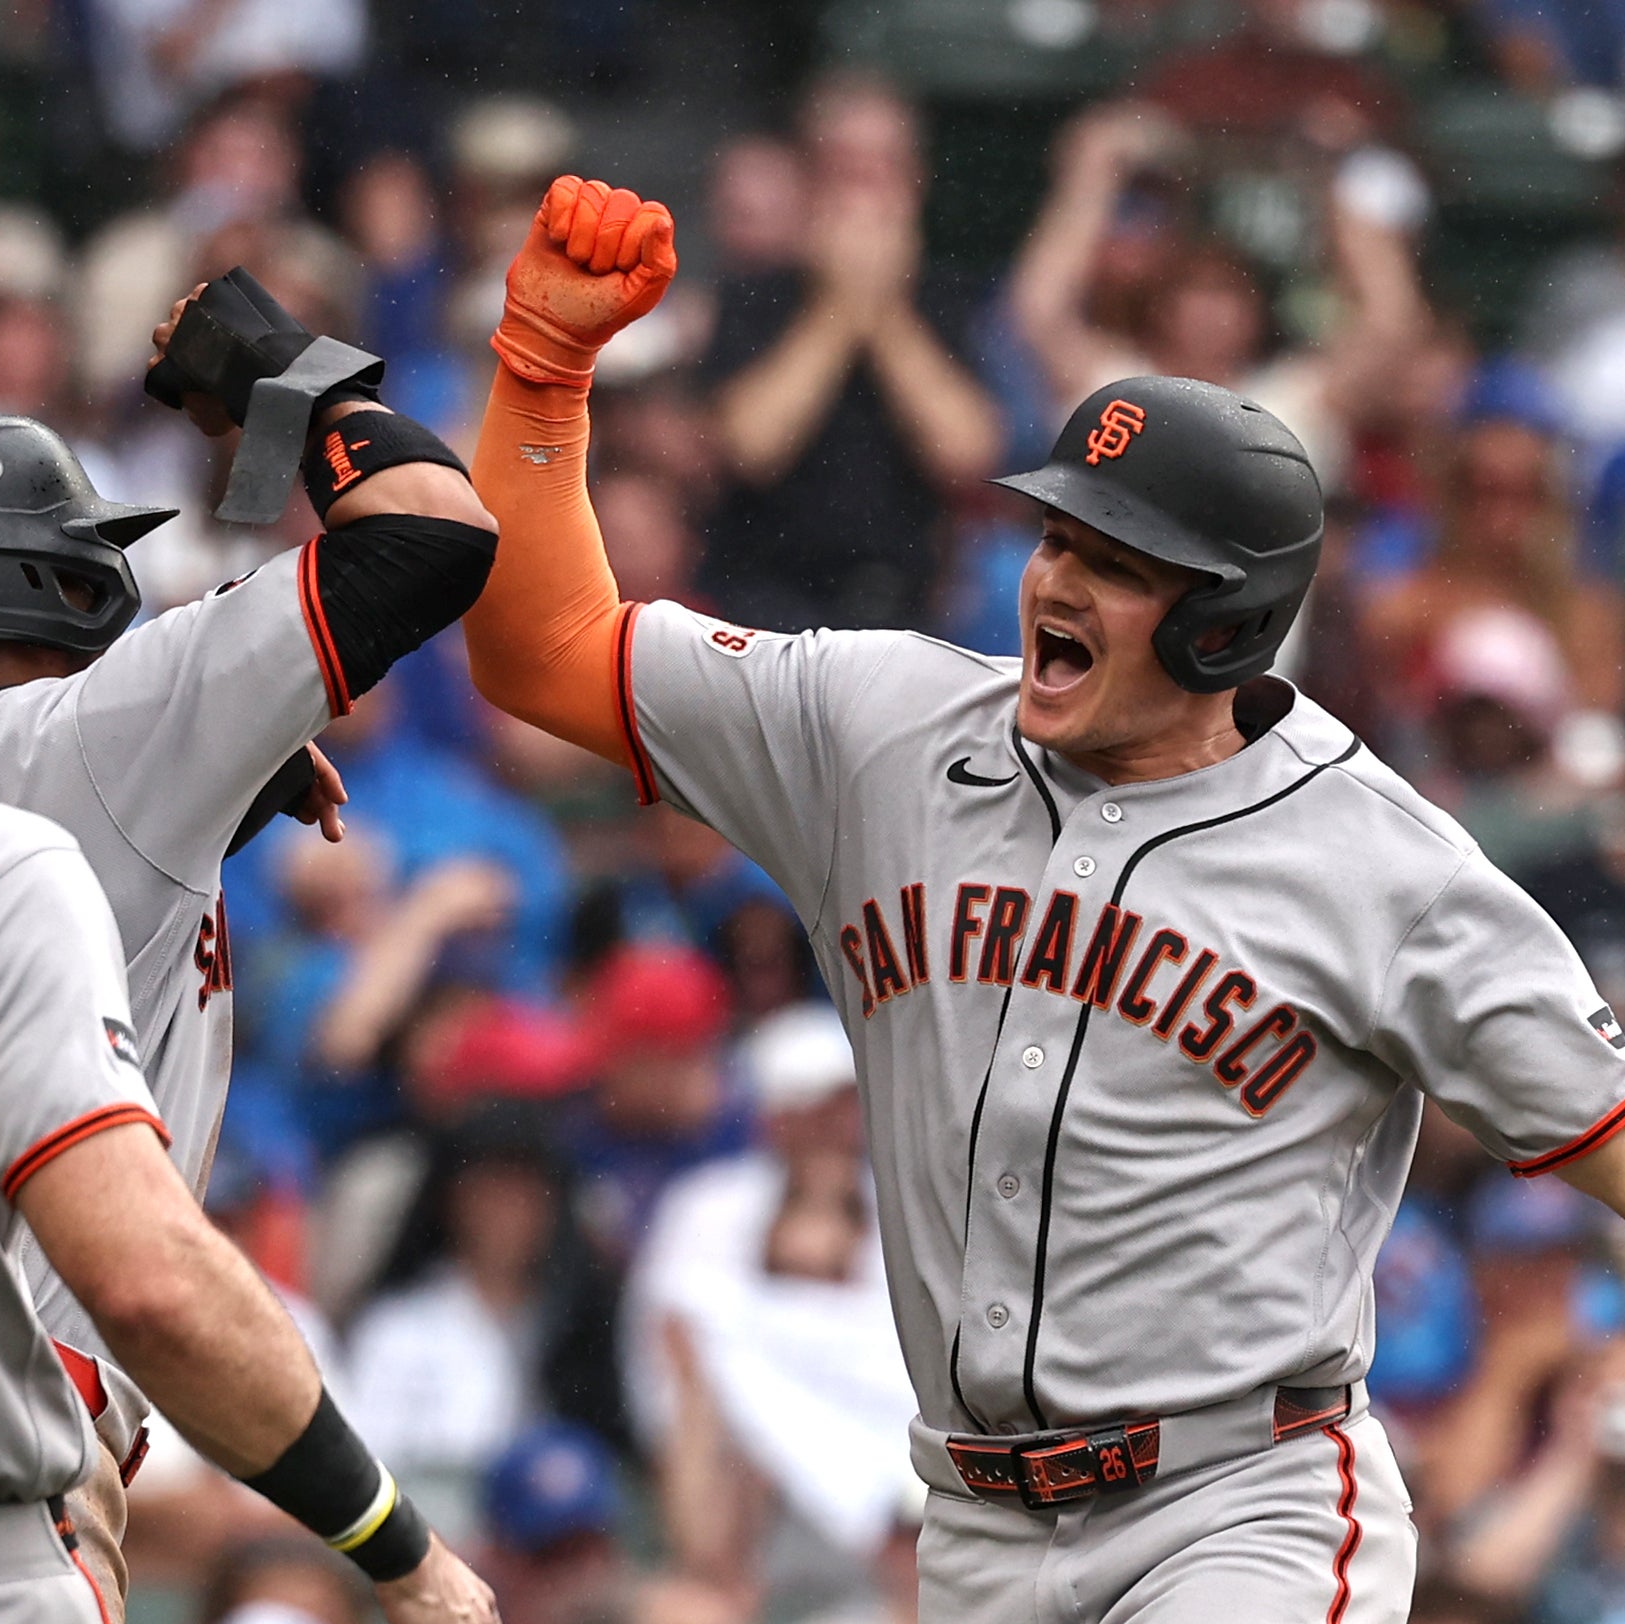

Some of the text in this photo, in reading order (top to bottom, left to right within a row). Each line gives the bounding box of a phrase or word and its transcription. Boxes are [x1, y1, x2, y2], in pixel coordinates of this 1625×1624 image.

[1085, 399, 1146, 466] SF
[840, 882, 1317, 1119] SAN FRANCISCO
[1099, 1446, 1127, 1482] 26
